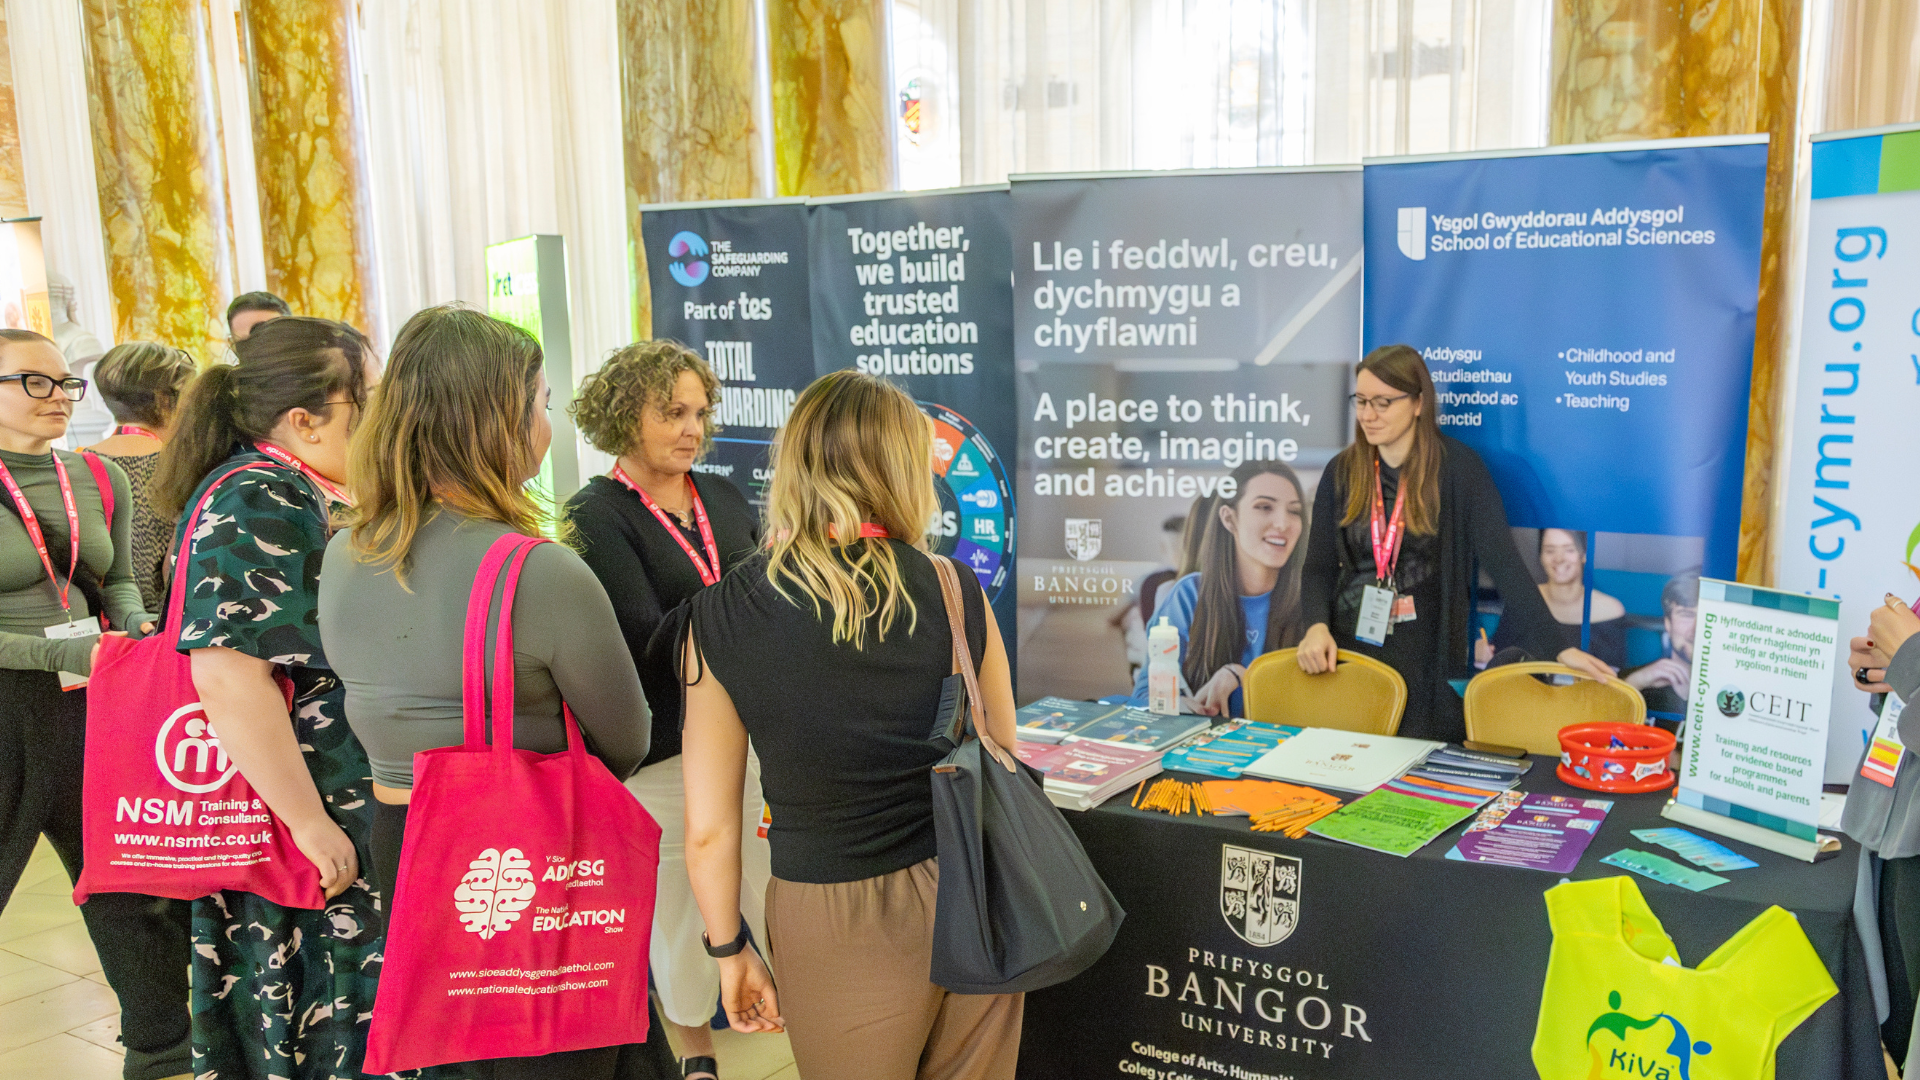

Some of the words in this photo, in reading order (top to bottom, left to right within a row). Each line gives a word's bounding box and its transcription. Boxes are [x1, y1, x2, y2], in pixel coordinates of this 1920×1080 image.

[1431, 213, 1478, 234] Ysgol
[1481, 210, 1587, 232] Gwyddorau
[1590, 205, 1684, 227] Addysgol
[711, 240, 732, 252] THE
[847, 222, 970, 260] Together,
[1033, 240, 1083, 271] Lle
[1092, 240, 1100, 270] i
[1108, 237, 1237, 271] feddwl,
[1248, 242, 1338, 270] creu,
[1431, 233, 1489, 252] School
[1493, 232, 1512, 250] of
[1515, 228, 1622, 249] Educational
[1625, 227, 1716, 245] Sciences
[711, 252, 788, 265] SAFEGUARDING
[712, 265, 762, 277] COMPANY
[855, 262, 895, 286] we
[900, 252, 965, 284] build
[684, 301, 717, 320] Part
[718, 300, 736, 320] of
[738, 291, 772, 320] tes
[863, 284, 959, 316] trusted
[1033, 278, 1211, 316] dychmygu
[1220, 282, 1241, 307] a
[850, 315, 978, 346] education
[1034, 316, 1197, 354] chyflawni
[705, 340, 756, 381] TOTAL
[856, 346, 974, 375] solutions
[1424, 346, 1482, 364] Addysgu
[1566, 347, 1643, 363] Childhood
[1645, 348, 1675, 363] and
[1431, 368, 1512, 383] studiaethau
[1565, 371, 1607, 386] Youth
[1609, 370, 1668, 386] Studies
[1033, 392, 1058, 422] A
[1066, 392, 1158, 429] place
[1166, 394, 1202, 422] to
[1211, 392, 1311, 426] think,
[1500, 393, 1519, 405] ac
[1563, 393, 1630, 412] Teaching
[1436, 412, 1482, 426] enctid
[1034, 432, 1150, 463] create,
[1160, 431, 1298, 468] imagine
[1034, 468, 1095, 496] and
[1104, 468, 1238, 498] achieve
[974, 518, 996, 535] HR
[1034, 575, 1134, 594] BANGOR
[1720, 615, 1773, 633] Hyfforddiant
[1775, 627, 1785, 636] ac
[1787, 629, 1833, 644] adnoddau
[1729, 631, 1738, 640] ar
[1740, 633, 1762, 644] gyfer
[1764, 637, 1807, 653] rhaglenni
[1809, 646, 1820, 657] yn
[1722, 643, 1756, 659] seiledig
[1758, 650, 1767, 658] ar
[1769, 651, 1819, 669] dystiolaeth
[1735, 658, 1771, 672] ysgolion
[1773, 666, 1779, 674] a
[1781, 667, 1808, 680] rhieni
[1689, 612, 1717, 778] www.ceit-cymru.org
[1750, 691, 1812, 722] CEIT
[1715, 734, 1749, 753] Training
[1751, 745, 1768, 755] and
[1769, 749, 1812, 767] resources
[1721, 748, 1733, 759] for
[1735, 753, 1773, 770] evidence
[1776, 762, 1803, 777] based
[1710, 770, 1721, 781] for
[1724, 775, 1754, 790] schools
[1757, 785, 1773, 796] and
[1775, 790, 1810, 806] parents
[1732, 766, 1787, 786] programmes
[116, 796, 194, 826] NSM
[200, 799, 248, 812] Training
[251, 799, 262, 810] &
[114, 831, 272, 848] www.nsmtc.co.uk
[173, 862, 195, 870] training
[533, 908, 625, 932] EDUCATION
[536, 906, 549, 914] The
[604, 926, 624, 934] Show
[1189, 947, 1330, 990] PRIFYSGOL
[1145, 964, 1373, 1042] BANGOR
[1181, 1012, 1334, 1059] UNIVERSITY
[1118, 1059, 1156, 1080] Coleg
[1157, 1070, 1166, 1080] y
[1131, 1041, 1180, 1064] College
[1181, 1053, 1196, 1066] of
[1197, 1056, 1228, 1077] Arts,
[1610, 1048, 1670, 1080] KiVa
